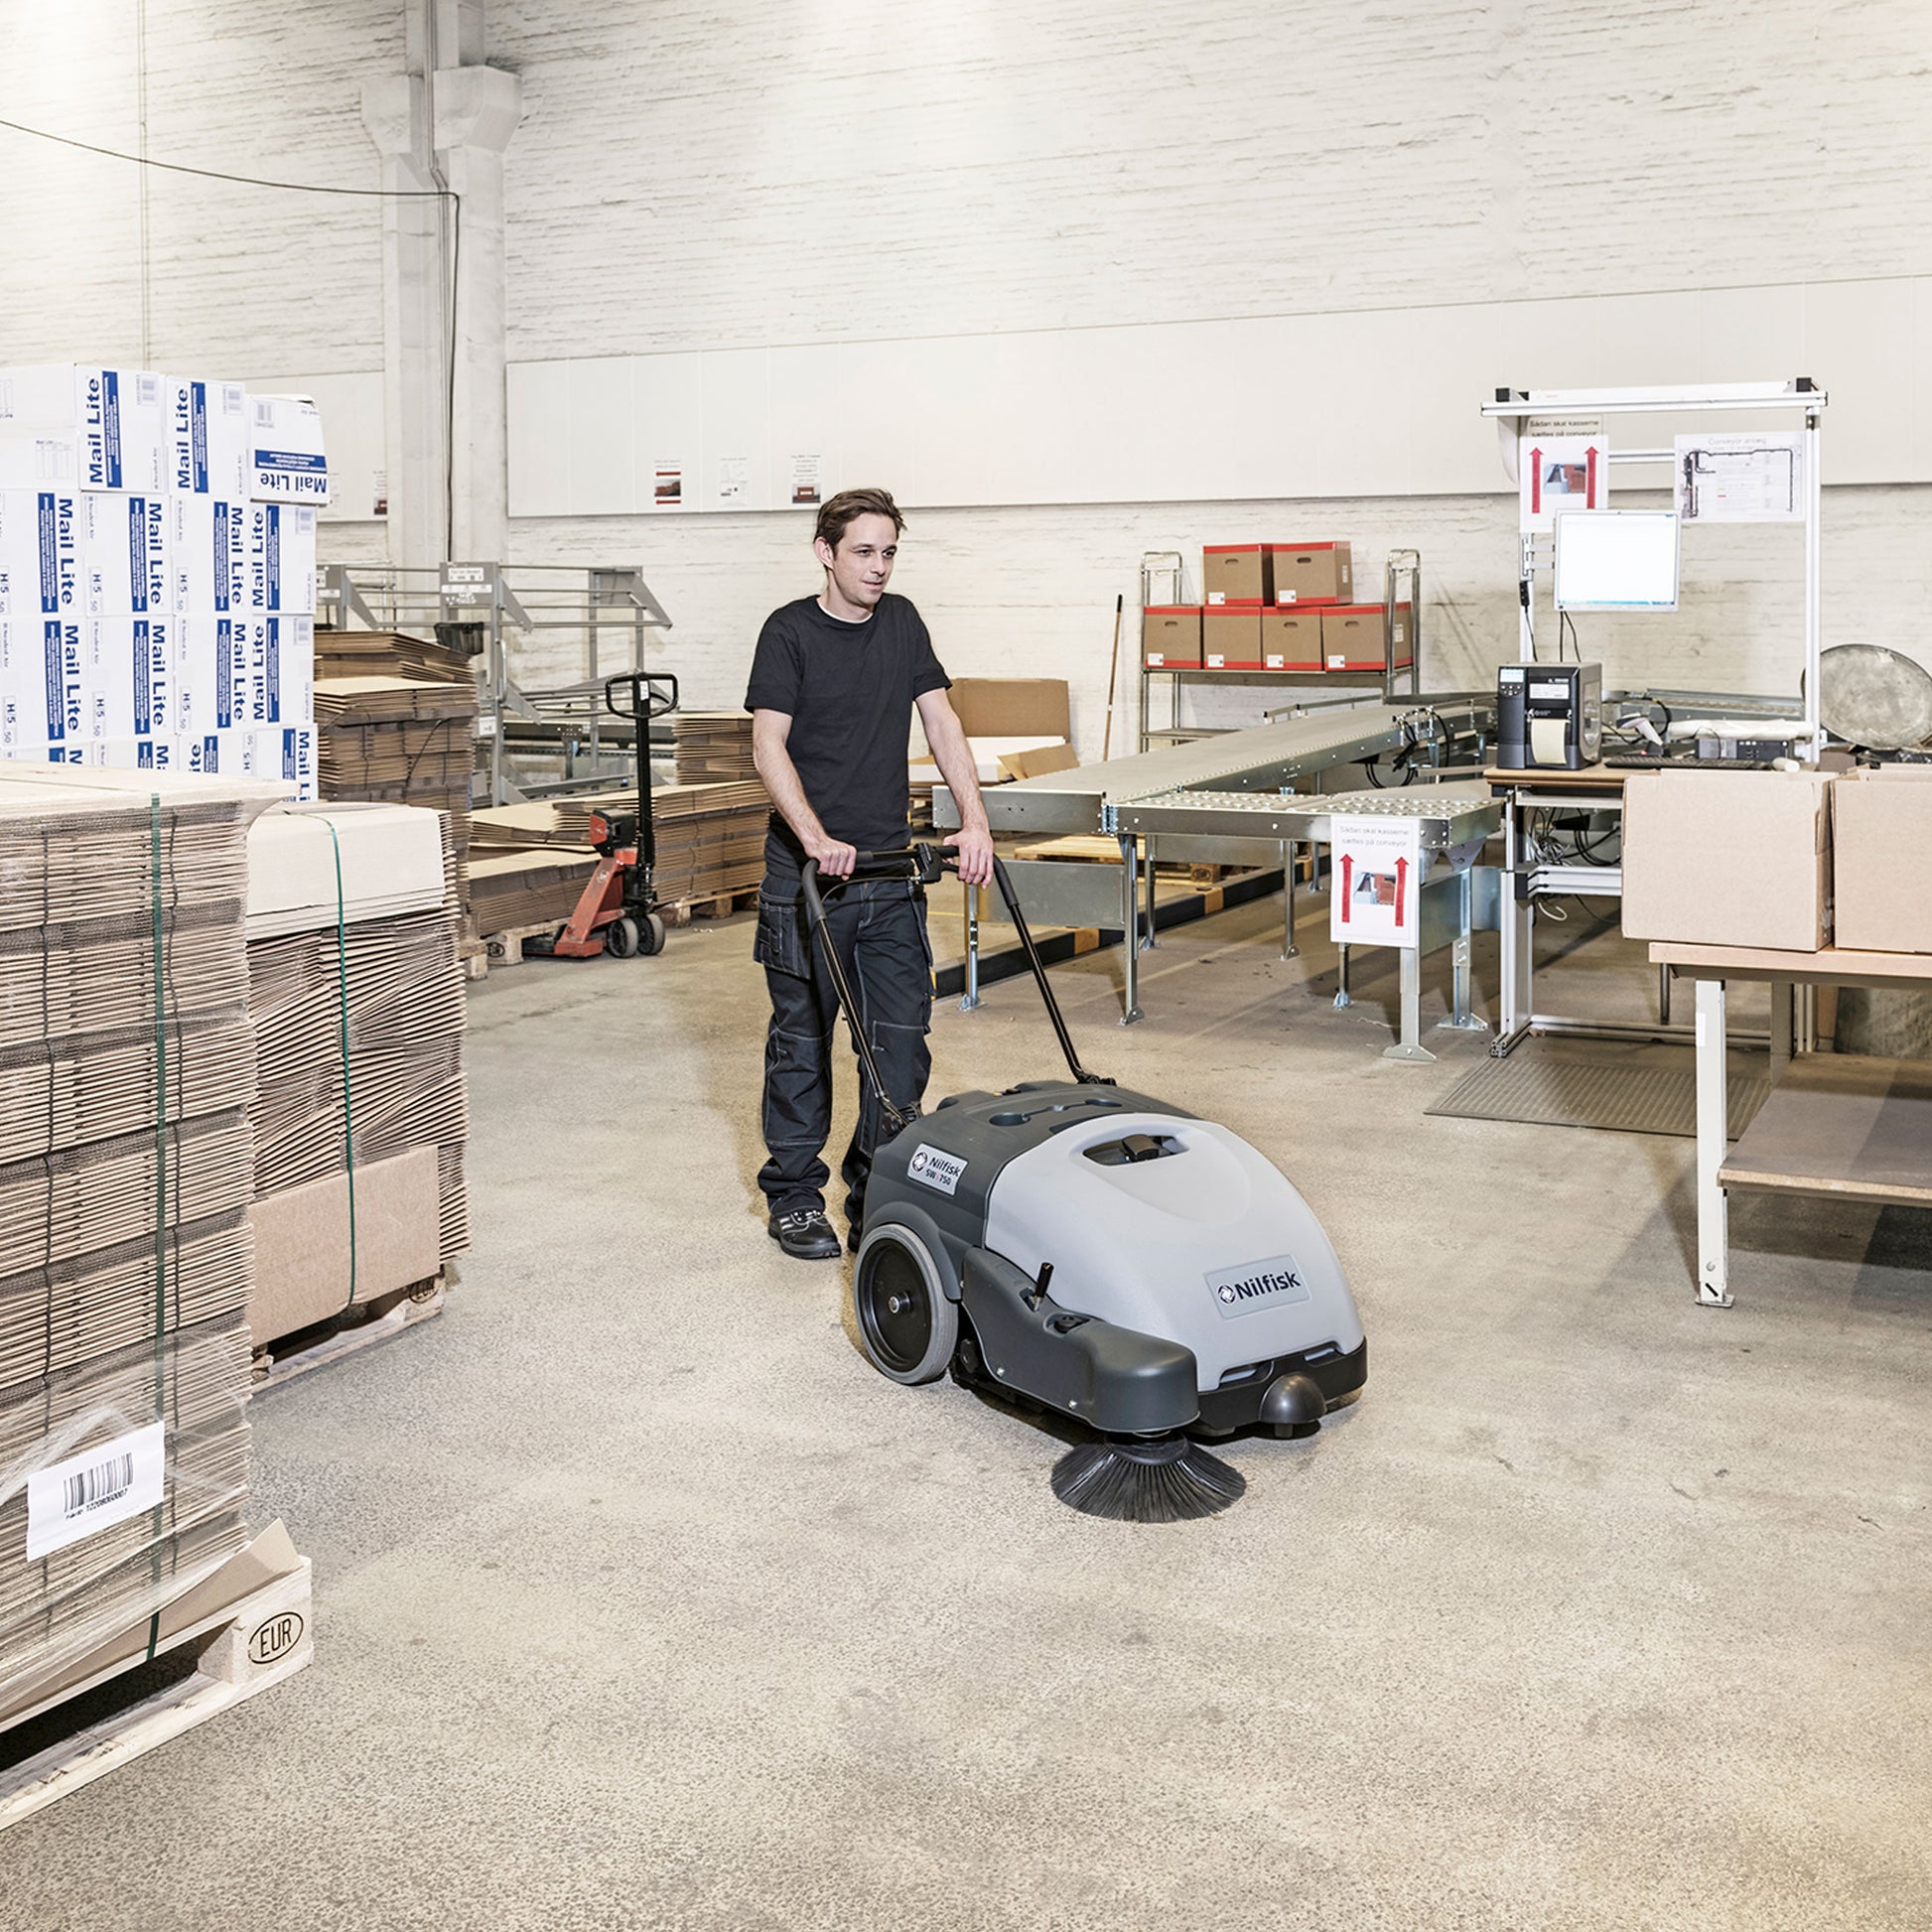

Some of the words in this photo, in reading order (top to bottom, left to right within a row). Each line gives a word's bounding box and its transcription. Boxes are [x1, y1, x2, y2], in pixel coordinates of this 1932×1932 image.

[86, 378, 100, 424] Lite
[175, 388, 189, 433] Lite
[87, 433, 103, 483] Mail
[176, 441, 191, 488] Mail
[260, 474, 290, 490] Lite
[295, 474, 328, 493] Mail
[59, 498, 73, 549] Mail
[148, 502, 163, 551] Mail
[230, 507, 243, 553] Mail
[251, 511, 264, 554] Lite
[61, 558, 74, 605] Lite
[150, 560, 163, 605] Lite
[231, 561, 244, 605] Lite
[252, 562, 264, 607] Mail
[65, 625, 79, 675] Mail
[152, 624, 166, 673] Mail
[233, 623, 246, 669] Mail
[252, 625, 264, 667] Lite
[67, 684, 81, 731] Lite
[153, 681, 167, 726] Lite
[233, 677, 246, 721] Lite
[252, 675, 265, 720] Mail
[189, 744, 202, 772] ite
[298, 731, 310, 775] Mail
[925, 1169, 937, 1179] SW
[939, 1173, 952, 1186] 750
[929, 1157, 961, 1177] Nilfisk
[1233, 1271, 1302, 1301] Nilfisk
[260, 1617, 292, 1659] EUR
